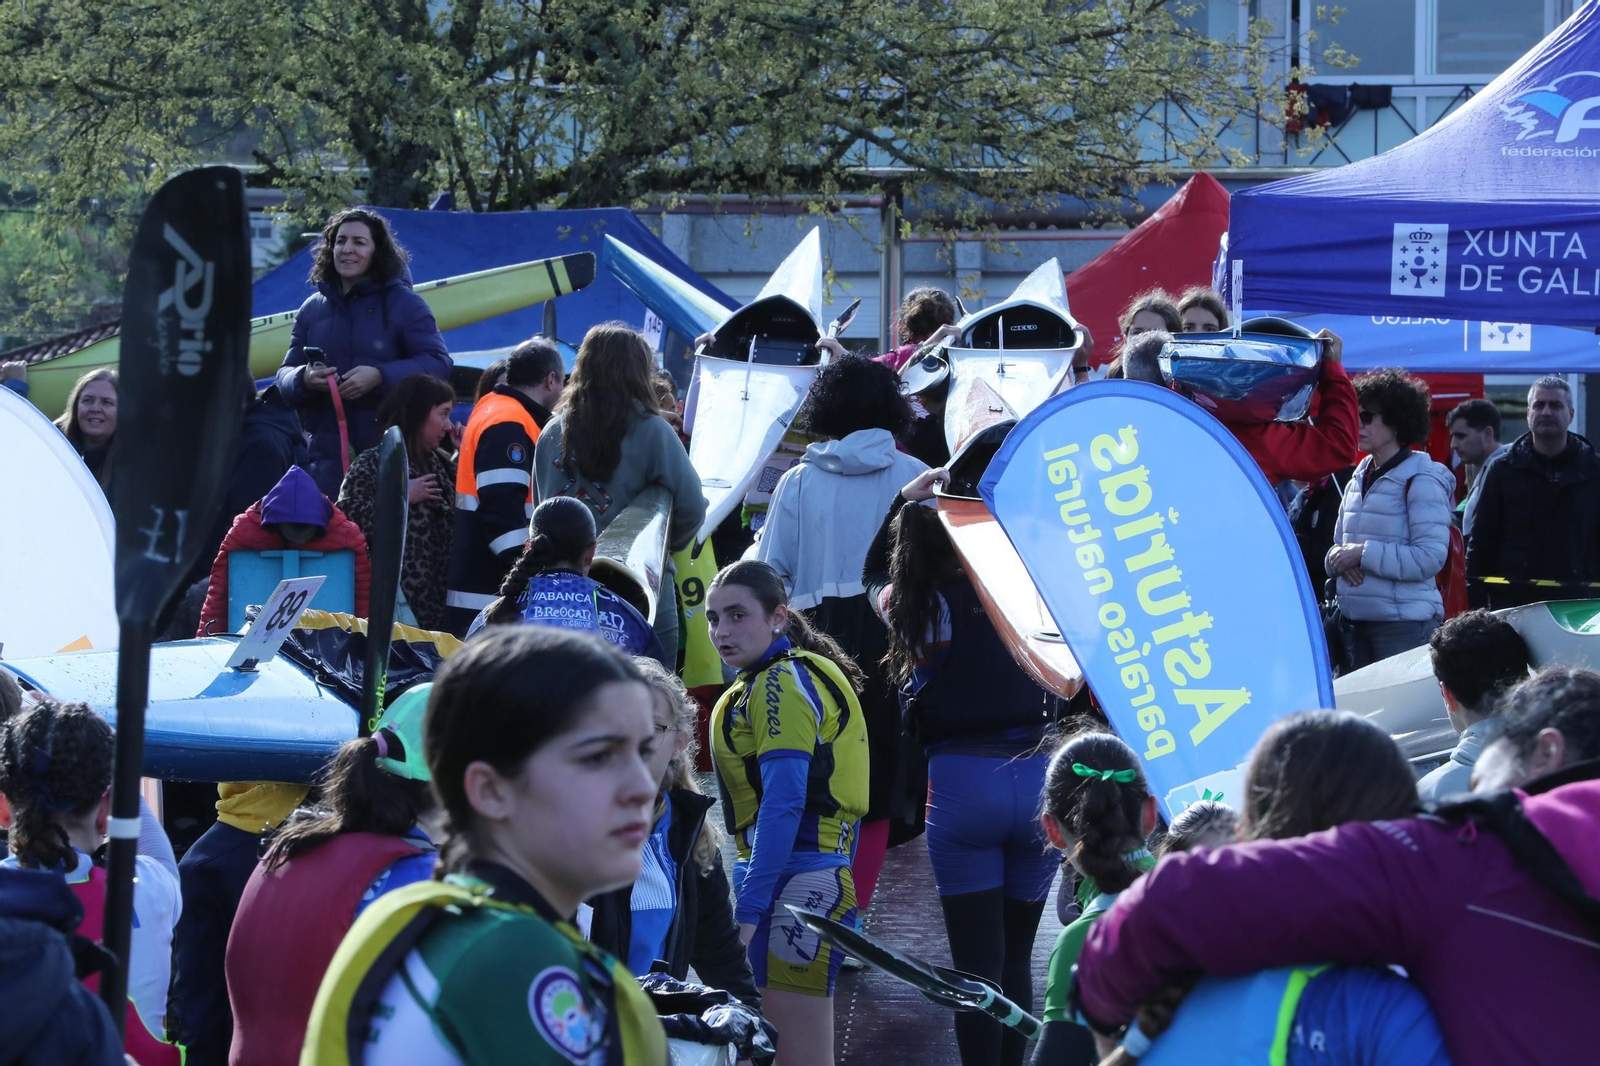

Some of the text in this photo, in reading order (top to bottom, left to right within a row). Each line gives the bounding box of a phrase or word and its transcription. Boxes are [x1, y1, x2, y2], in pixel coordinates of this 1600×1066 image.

[1462, 230, 1588, 259] XUNTA
[1460, 264, 1600, 296] DE GALI
[265, 589, 308, 631] 89
